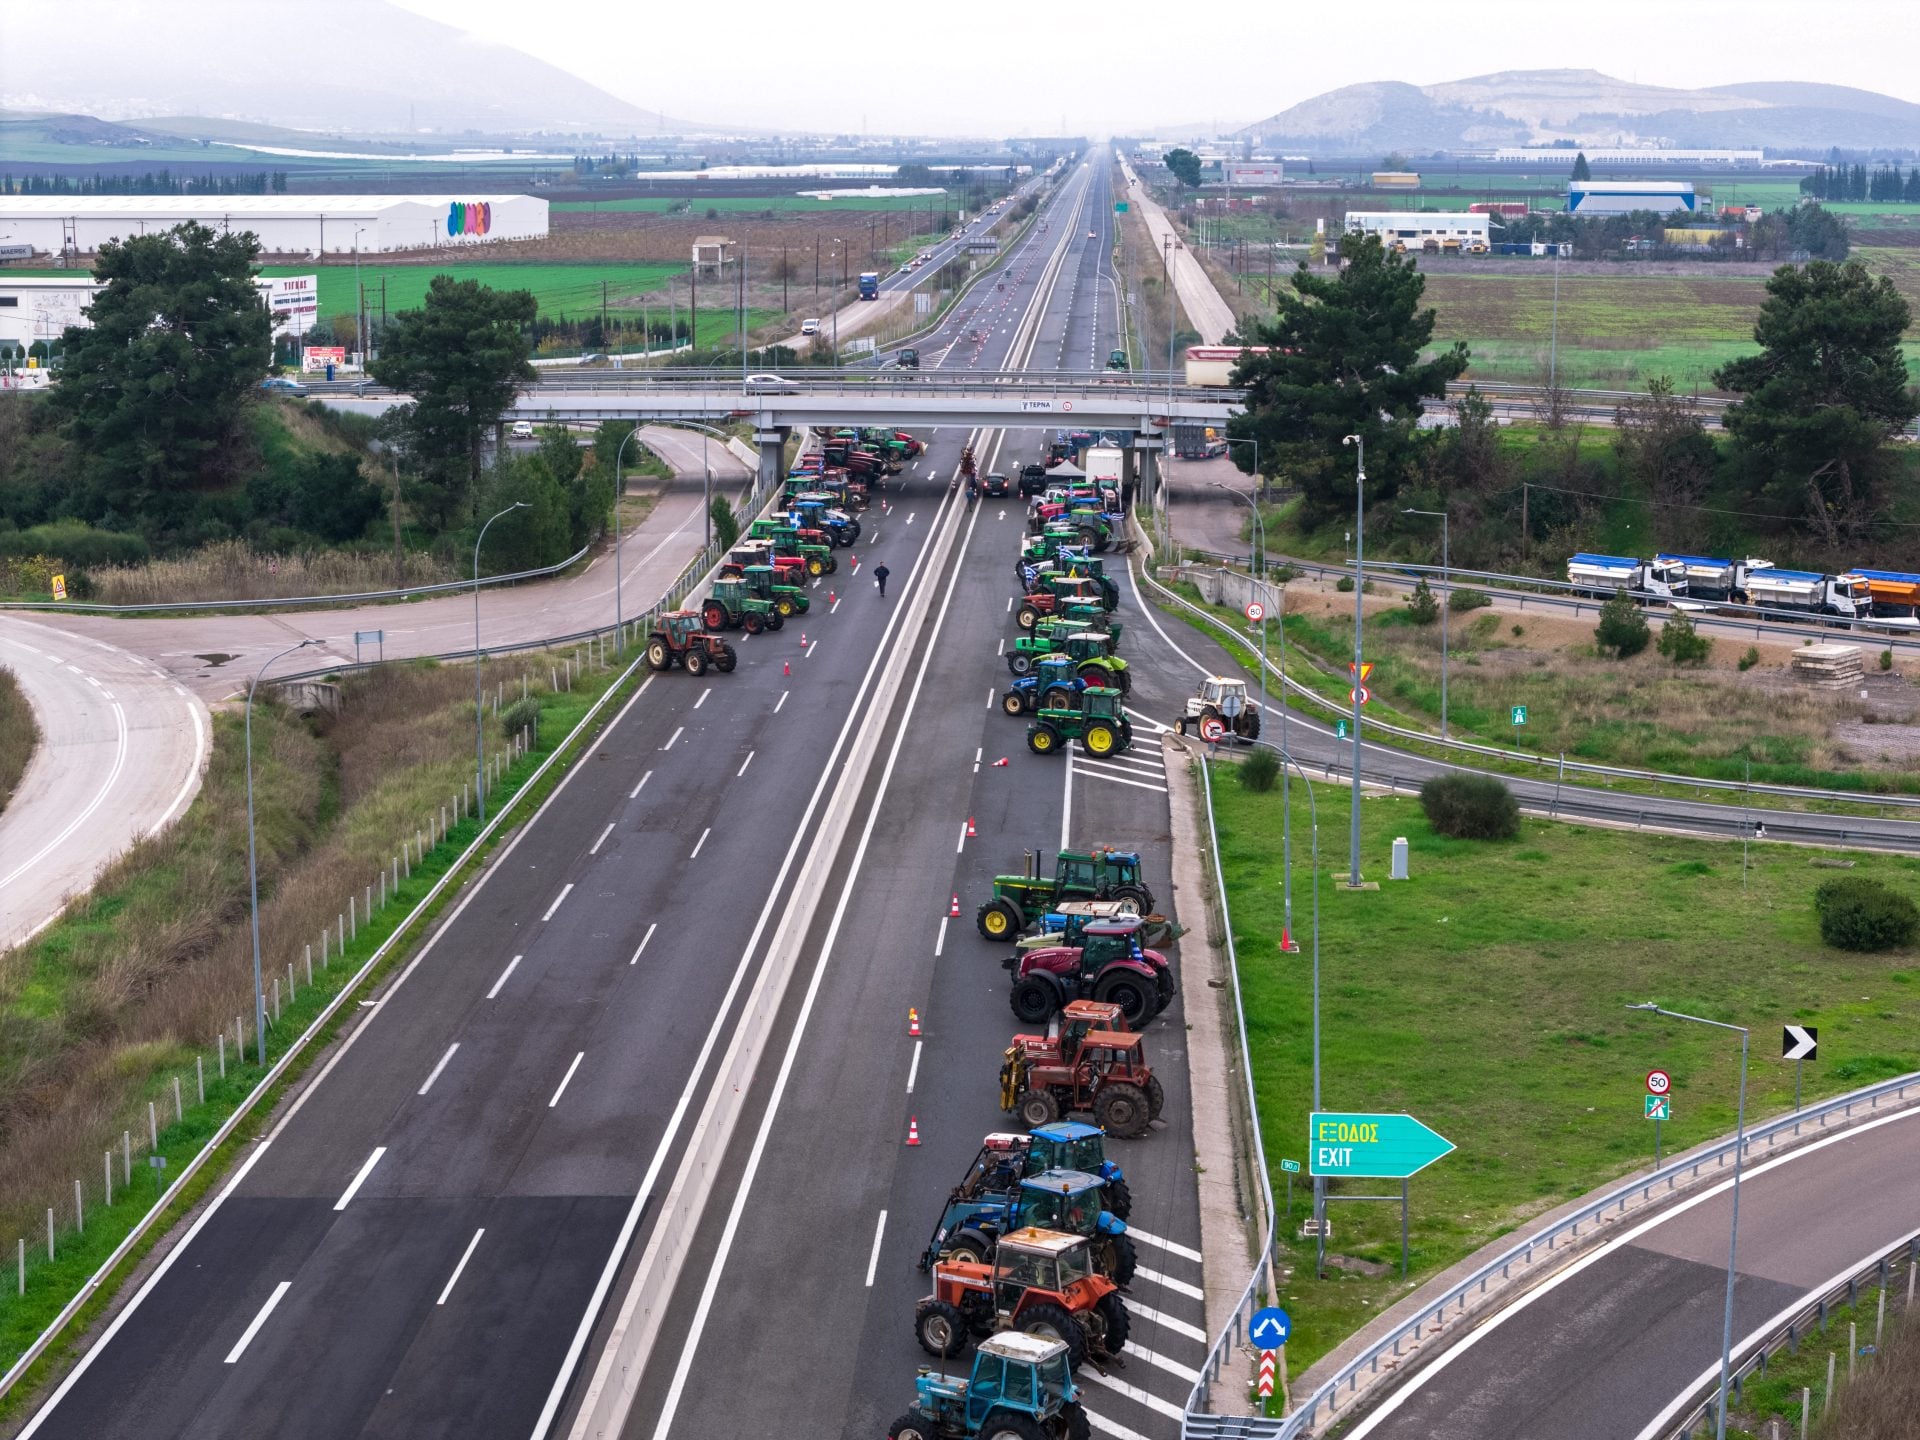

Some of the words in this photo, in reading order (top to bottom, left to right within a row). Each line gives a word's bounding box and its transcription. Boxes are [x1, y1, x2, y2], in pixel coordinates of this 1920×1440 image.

[1250, 608, 1261, 616] 80
[1650, 1076, 1666, 1088] 50
[1319, 1122, 1379, 1143] ΕΞΟΔΟΣ
[1318, 1147, 1354, 1167] EXIT
